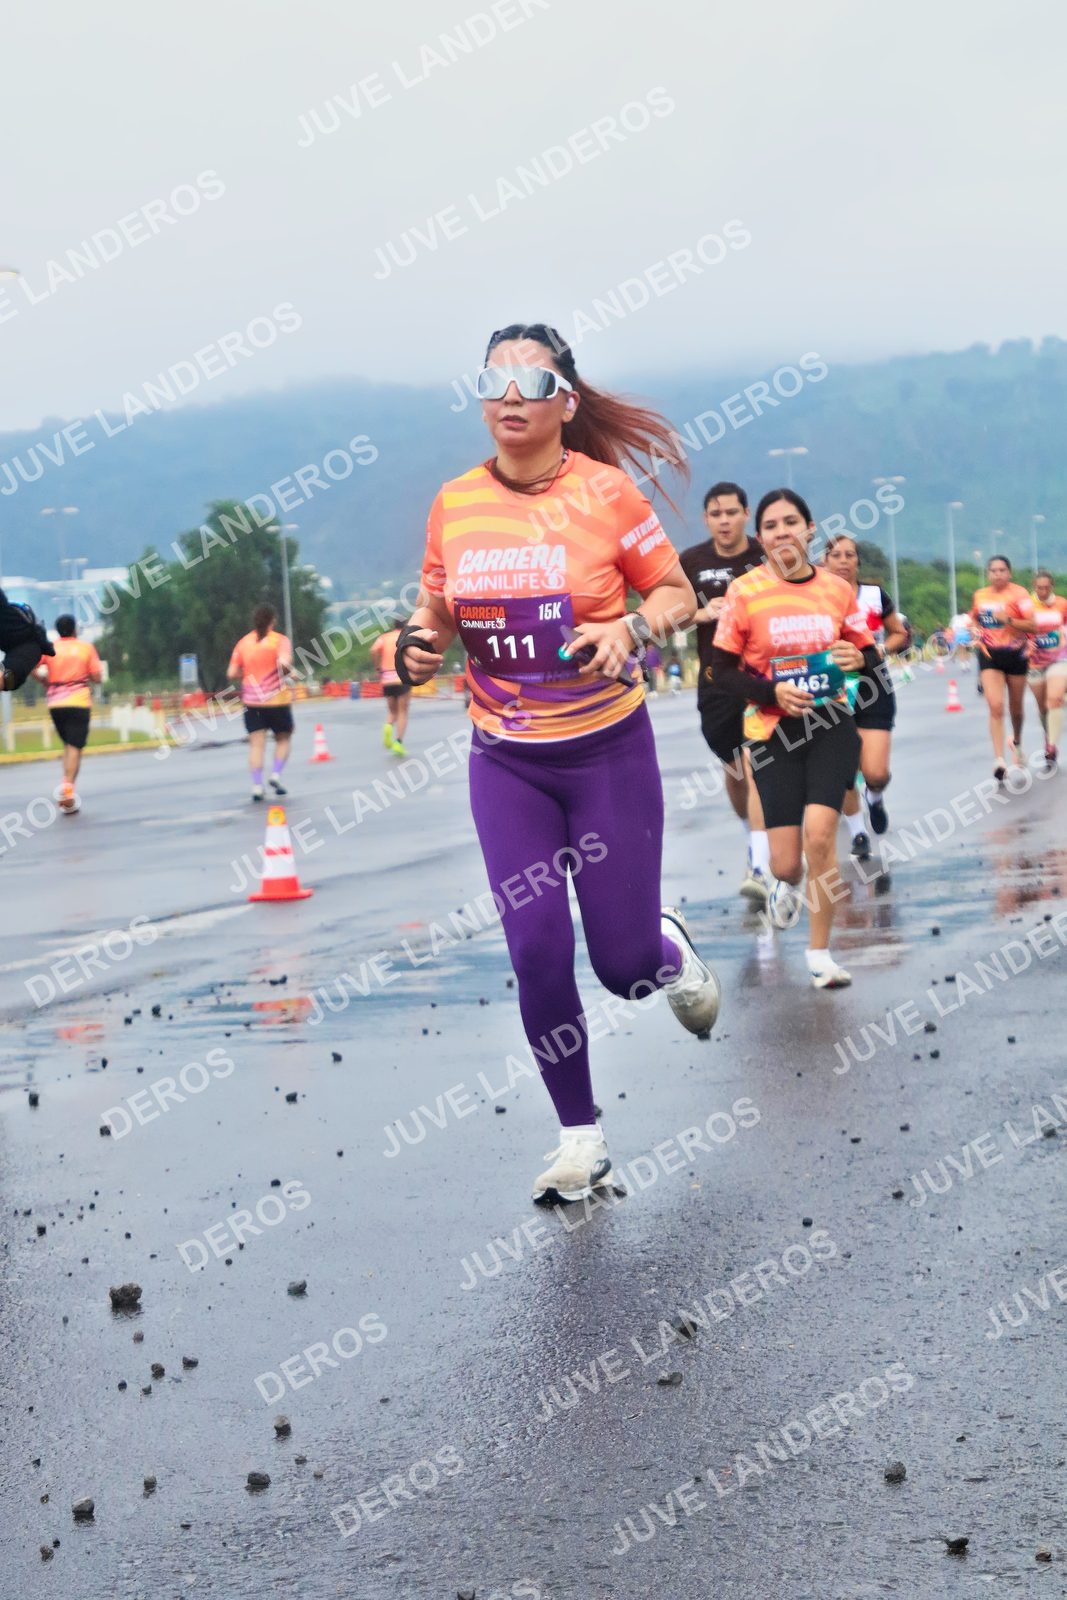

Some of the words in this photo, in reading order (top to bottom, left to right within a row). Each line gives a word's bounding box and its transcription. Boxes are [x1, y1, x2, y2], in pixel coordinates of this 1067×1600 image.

[457, 544, 567, 575] CARRERA
[459, 605, 506, 619] CARRERA
[538, 602, 562, 620] 15K
[486, 634, 536, 660] 111
